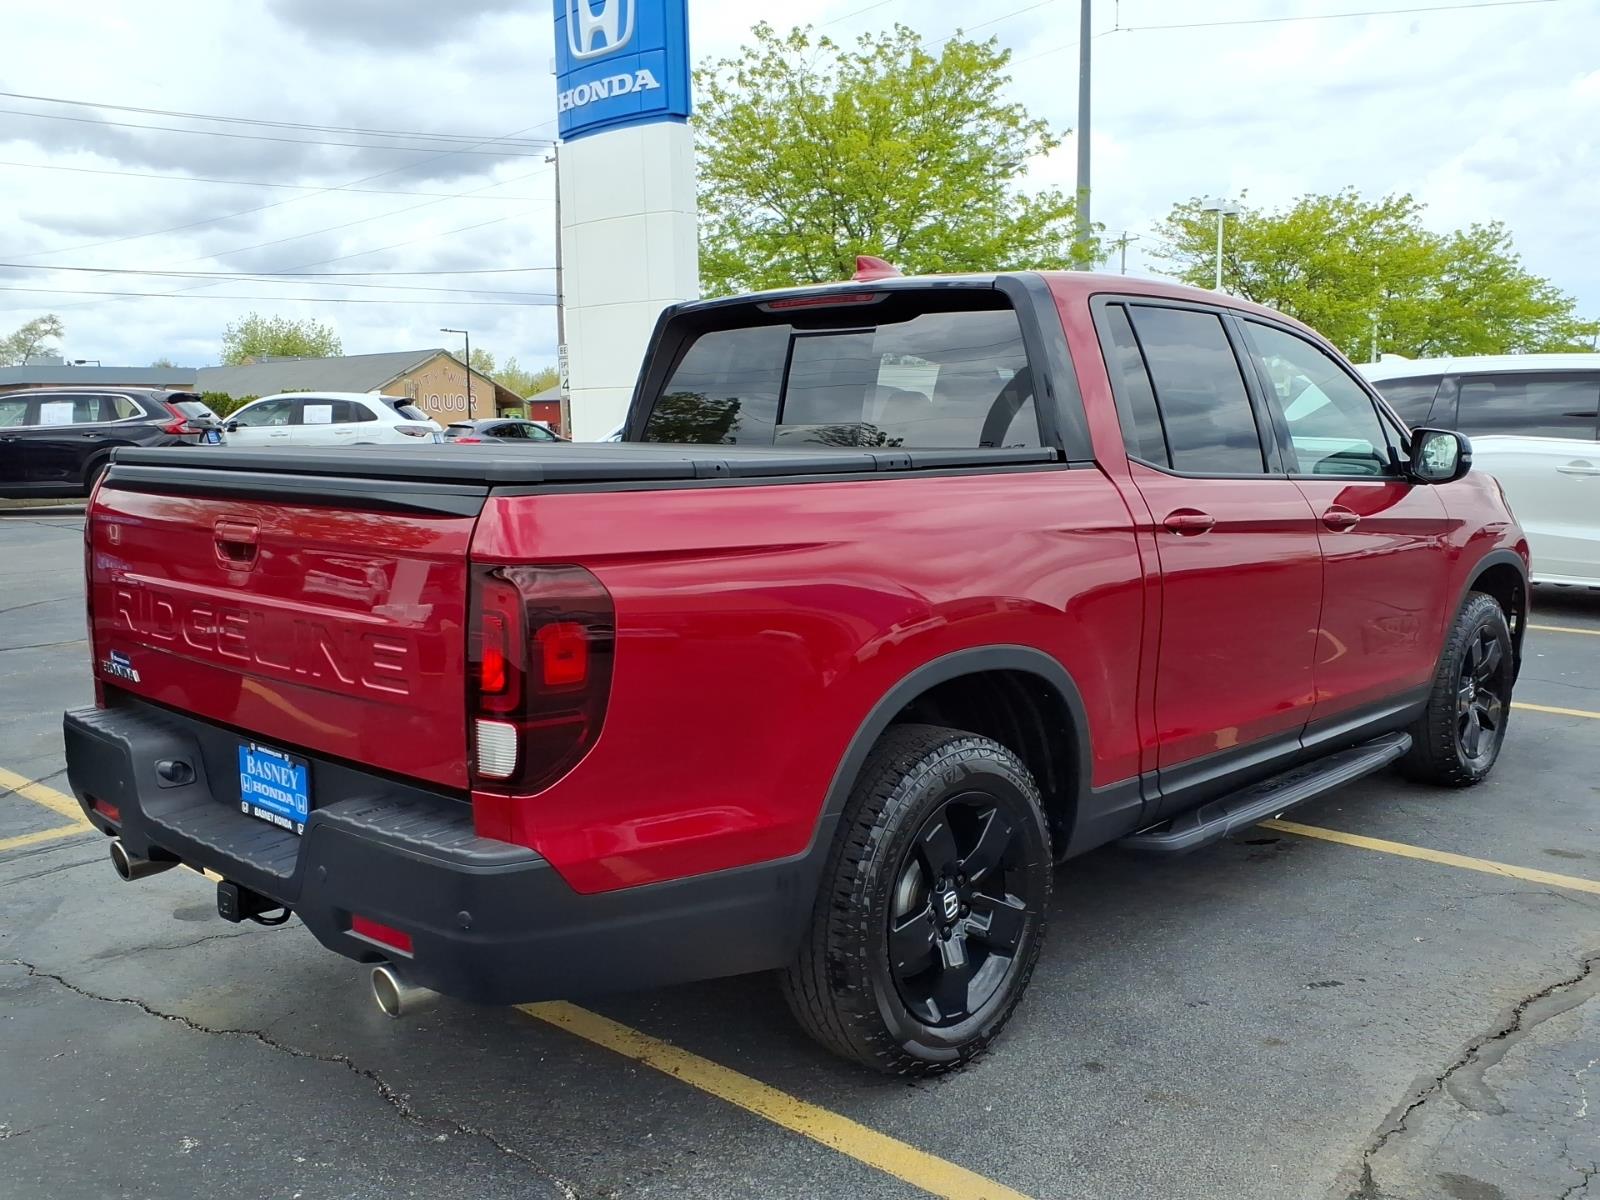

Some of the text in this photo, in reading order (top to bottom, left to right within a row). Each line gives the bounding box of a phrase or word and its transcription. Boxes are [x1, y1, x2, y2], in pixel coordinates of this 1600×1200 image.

[558, 69, 660, 113] HONDA
[561, 377, 570, 392] 4
[113, 587, 410, 695] RIDGELINE
[246, 755, 299, 790] BASNEY
[252, 780, 296, 807] HONDA
[254, 806, 292, 830] BASNEY HONDA
